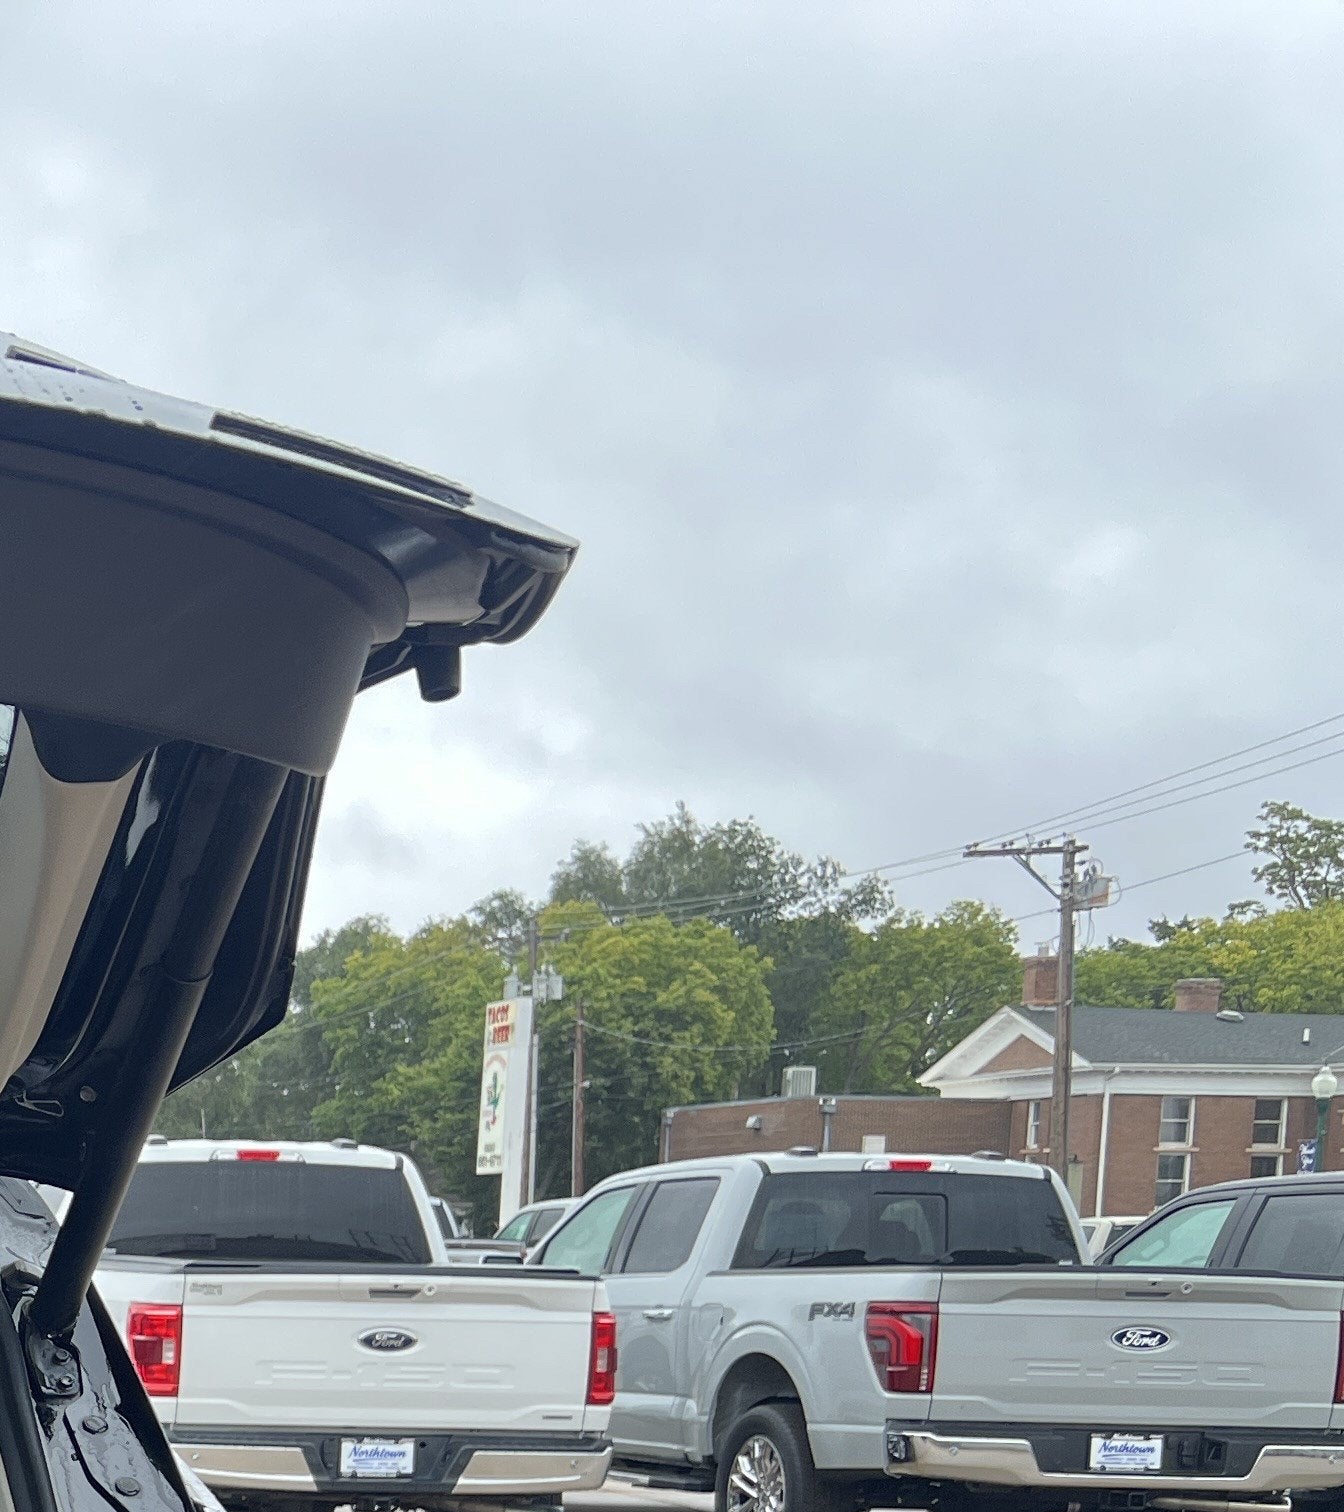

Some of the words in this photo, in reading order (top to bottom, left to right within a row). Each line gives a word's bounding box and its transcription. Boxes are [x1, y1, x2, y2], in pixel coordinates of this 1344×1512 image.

[808, 1302, 855, 1321] FX4
[1121, 1330, 1162, 1347] Ford
[348, 1444, 407, 1459] Northtown
[1098, 1441, 1156, 1454] Northtown
